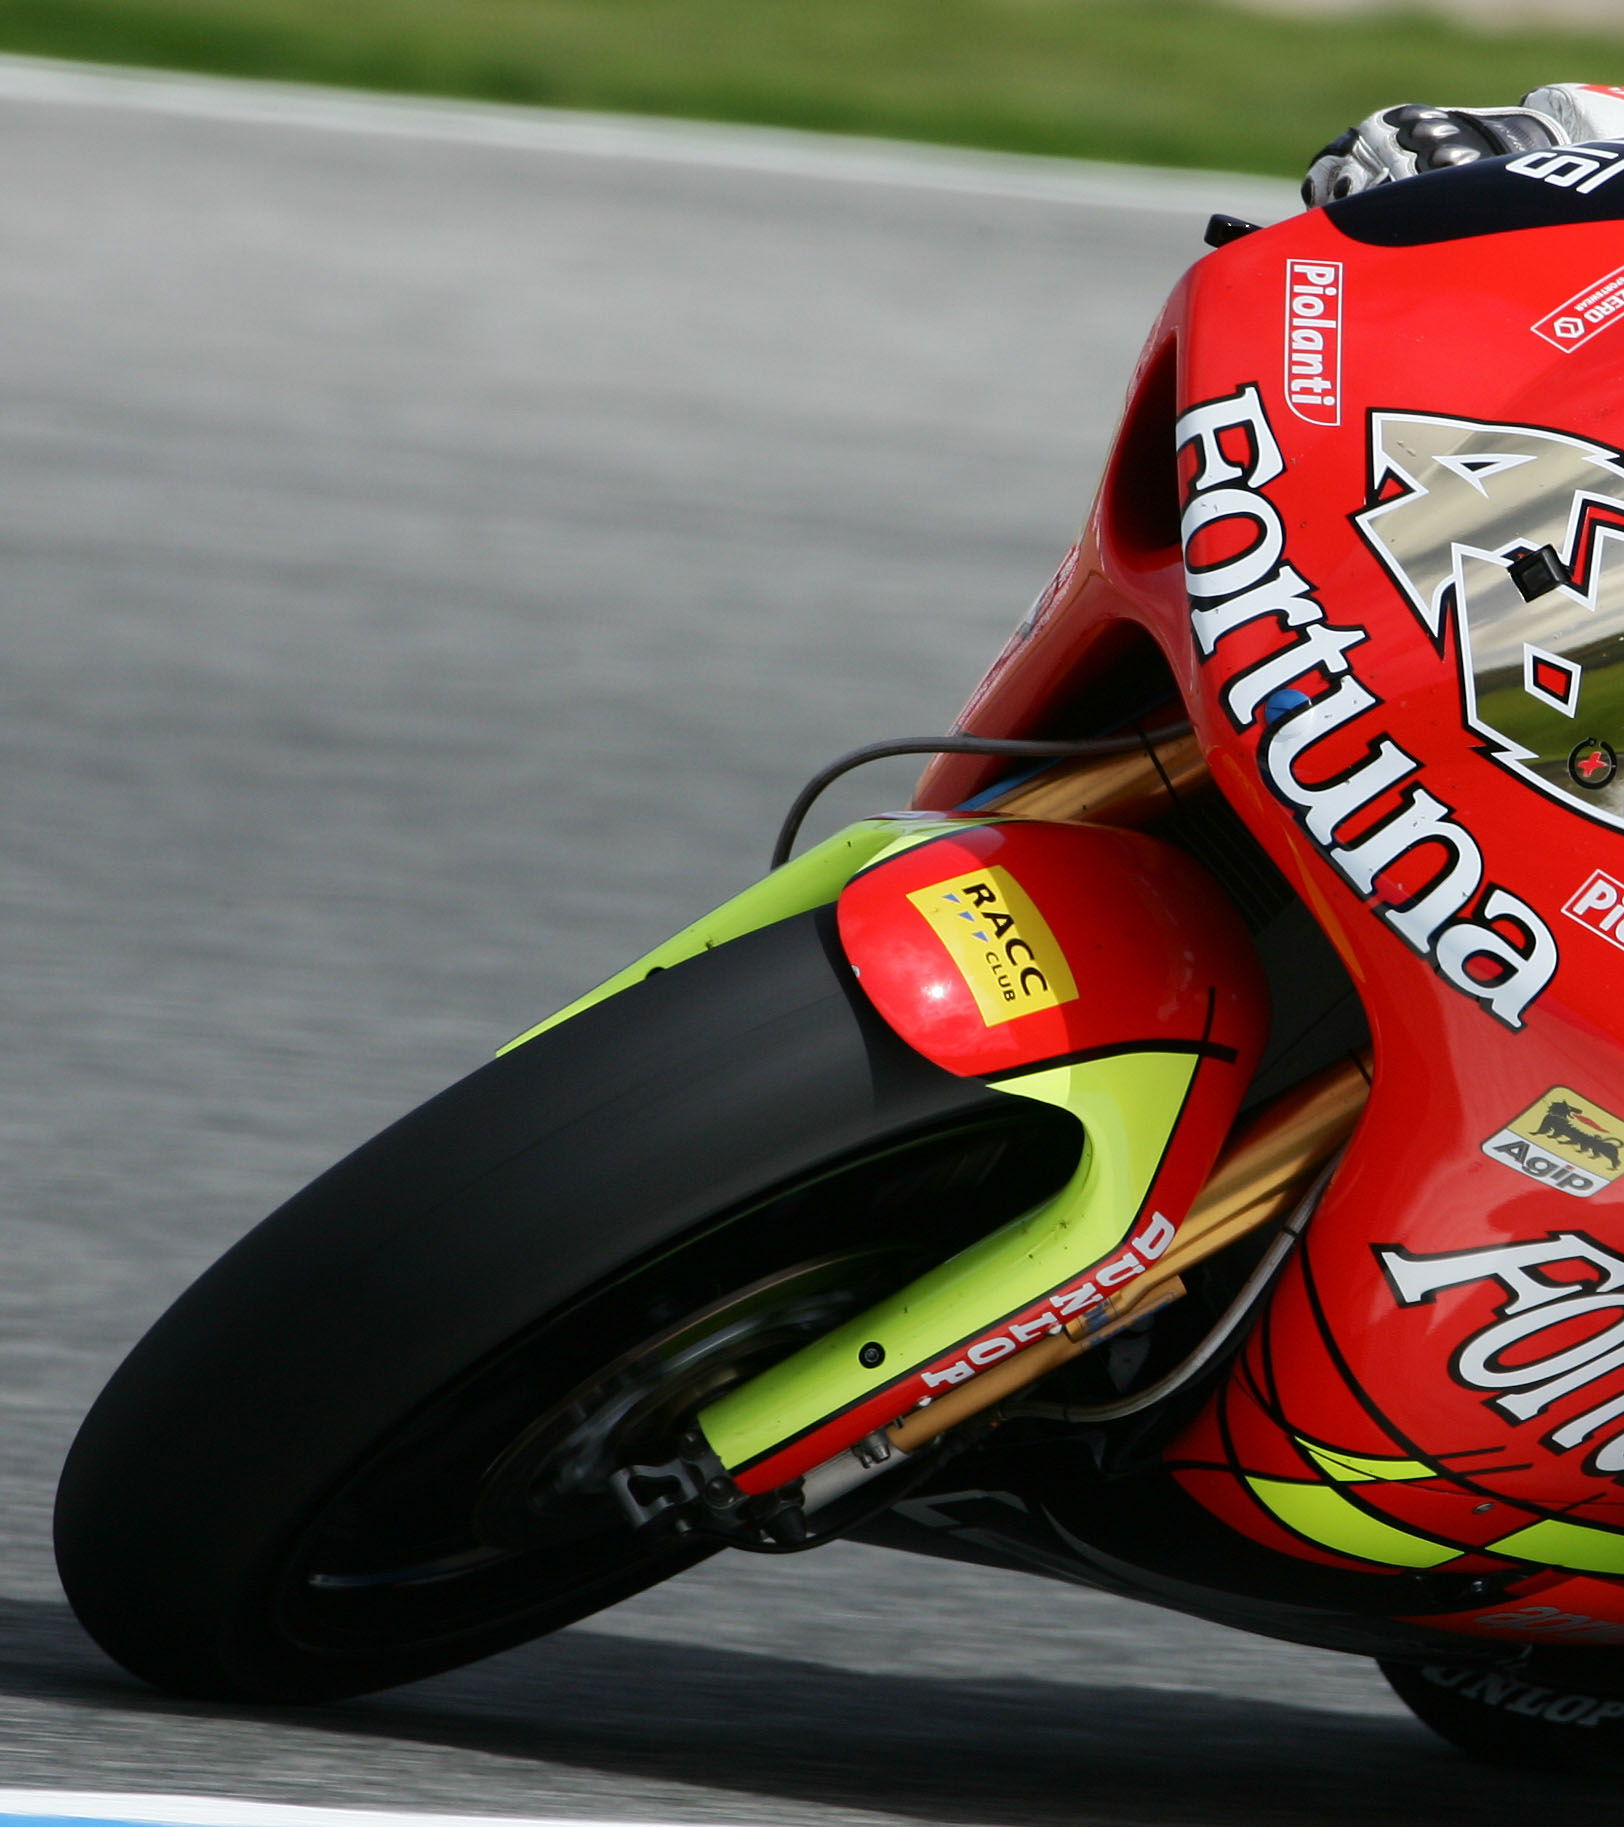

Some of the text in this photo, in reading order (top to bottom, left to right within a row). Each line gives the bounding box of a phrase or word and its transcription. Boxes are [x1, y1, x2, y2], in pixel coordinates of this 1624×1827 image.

[1292, 263, 1337, 407] Piolanti
[1176, 384, 1560, 1031] Fortuna
[961, 882, 1048, 998] RACC
[985, 951, 1016, 1004] CLUB
[1492, 1137, 1597, 1195] Agip
[921, 1211, 1176, 1388] DUNLOP
